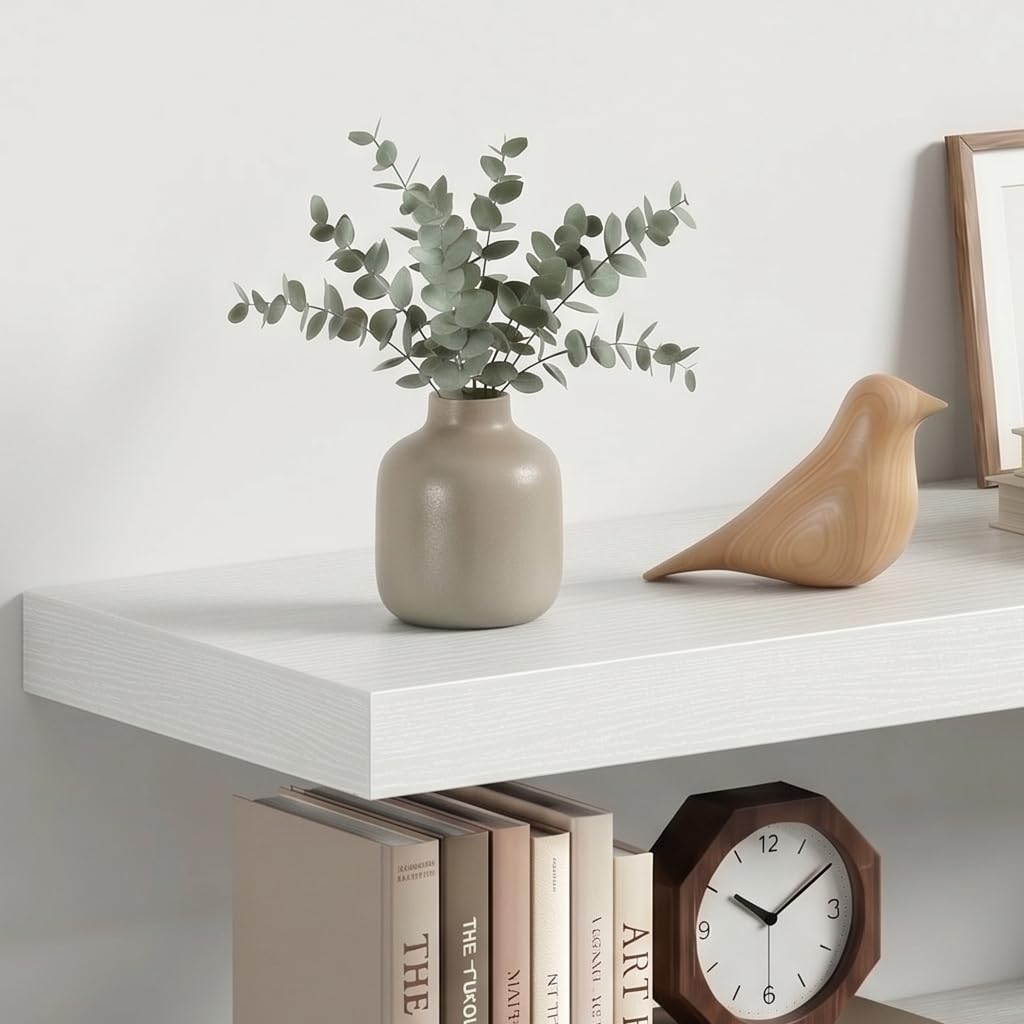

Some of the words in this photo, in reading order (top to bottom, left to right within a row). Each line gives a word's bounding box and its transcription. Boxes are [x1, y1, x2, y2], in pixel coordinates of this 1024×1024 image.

[758, 834, 779, 853] 12
[827, 898, 840, 920] 3
[462, 916, 477, 957] THE
[698, 920, 710, 940] 9
[622, 922, 650, 1001] ART
[403, 932, 429, 1016] THE
[763, 985, 776, 1005] 6
